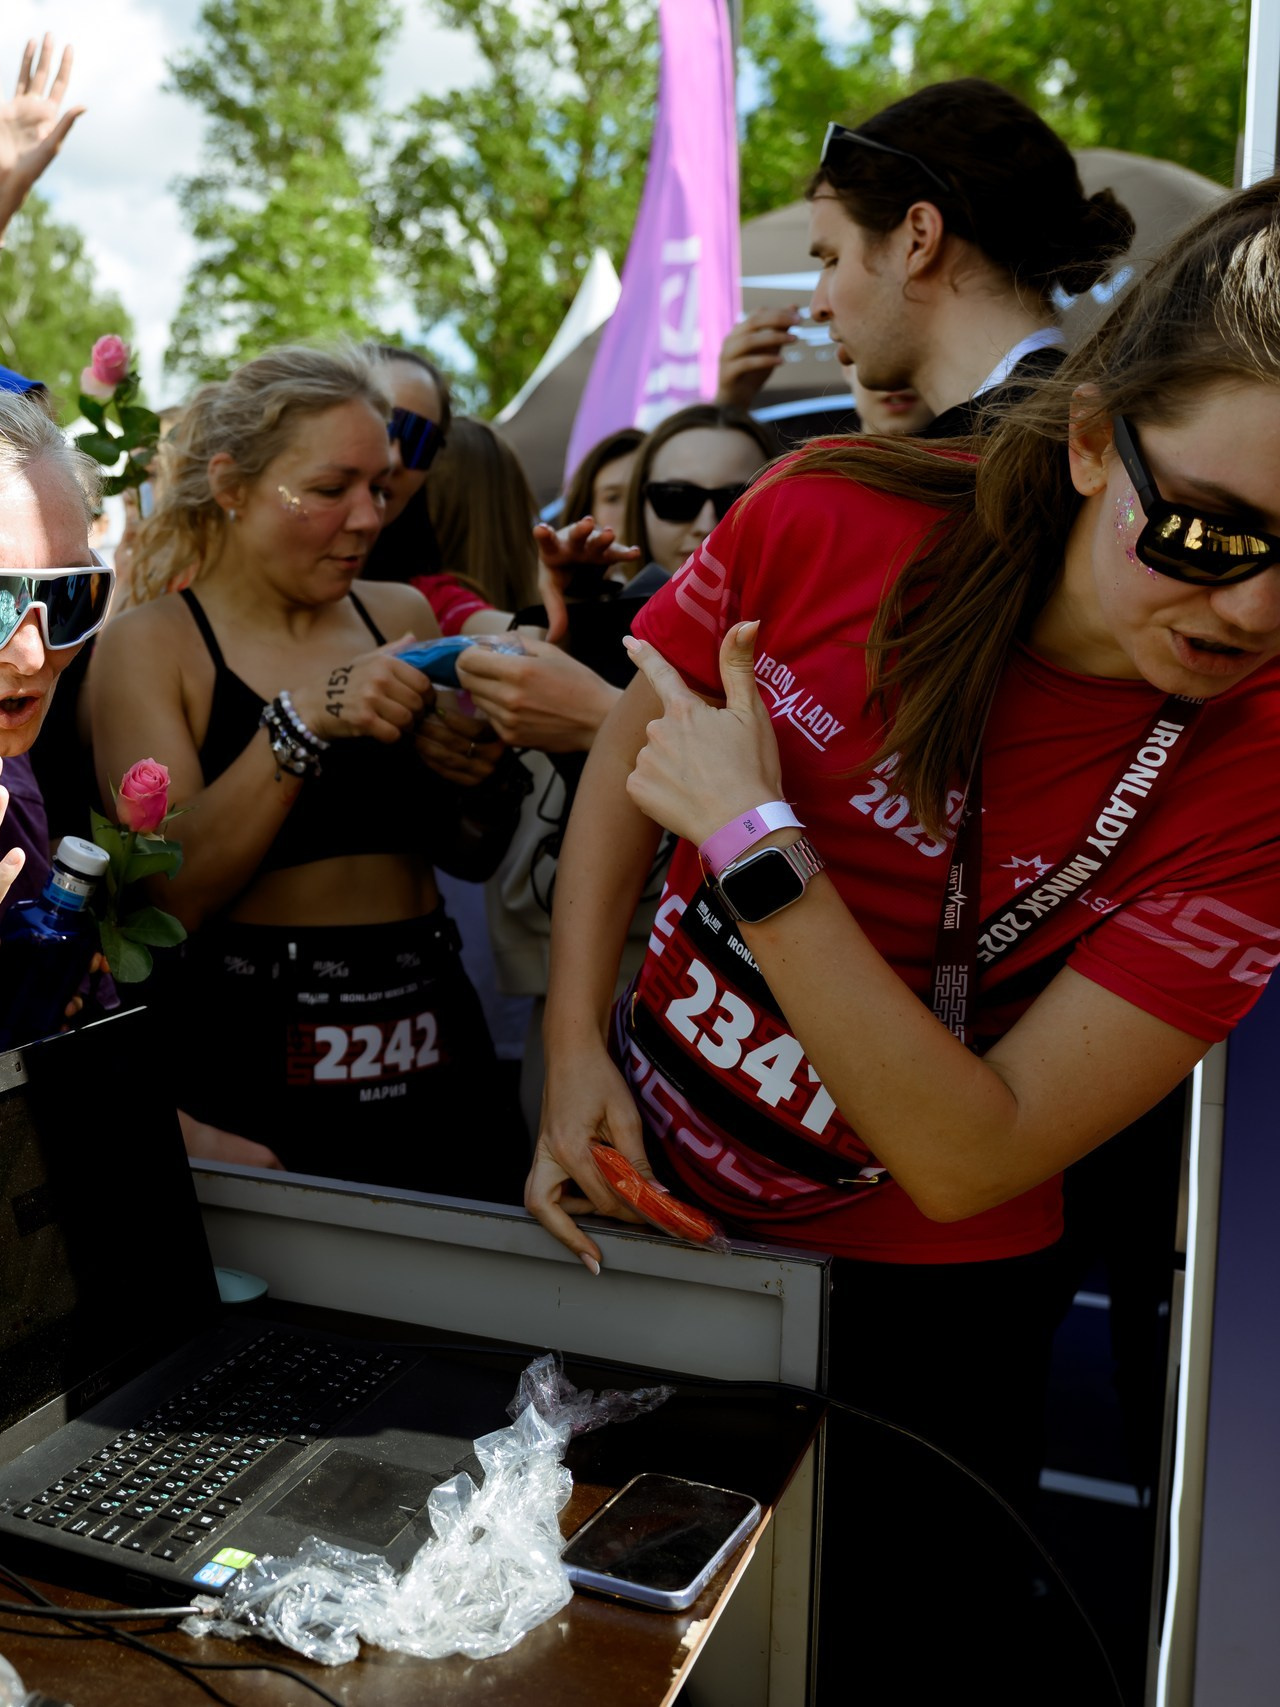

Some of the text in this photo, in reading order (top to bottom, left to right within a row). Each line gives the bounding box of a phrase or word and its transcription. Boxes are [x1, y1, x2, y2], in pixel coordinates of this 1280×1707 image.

[325, 665, 354, 718] 4152
[754, 652, 845, 743] IRON LADY
[1086, 719, 1185, 857] IRONLADY
[743, 819, 757, 835] 2341
[943, 864, 960, 930] IRON LADY
[1015, 854, 1103, 919] MINSK
[726, 934, 762, 974] IRONLA
[313, 1011, 441, 1082] 2242
[664, 957, 837, 1136] 2341
[359, 1081, 409, 1103] МАРИЯ
